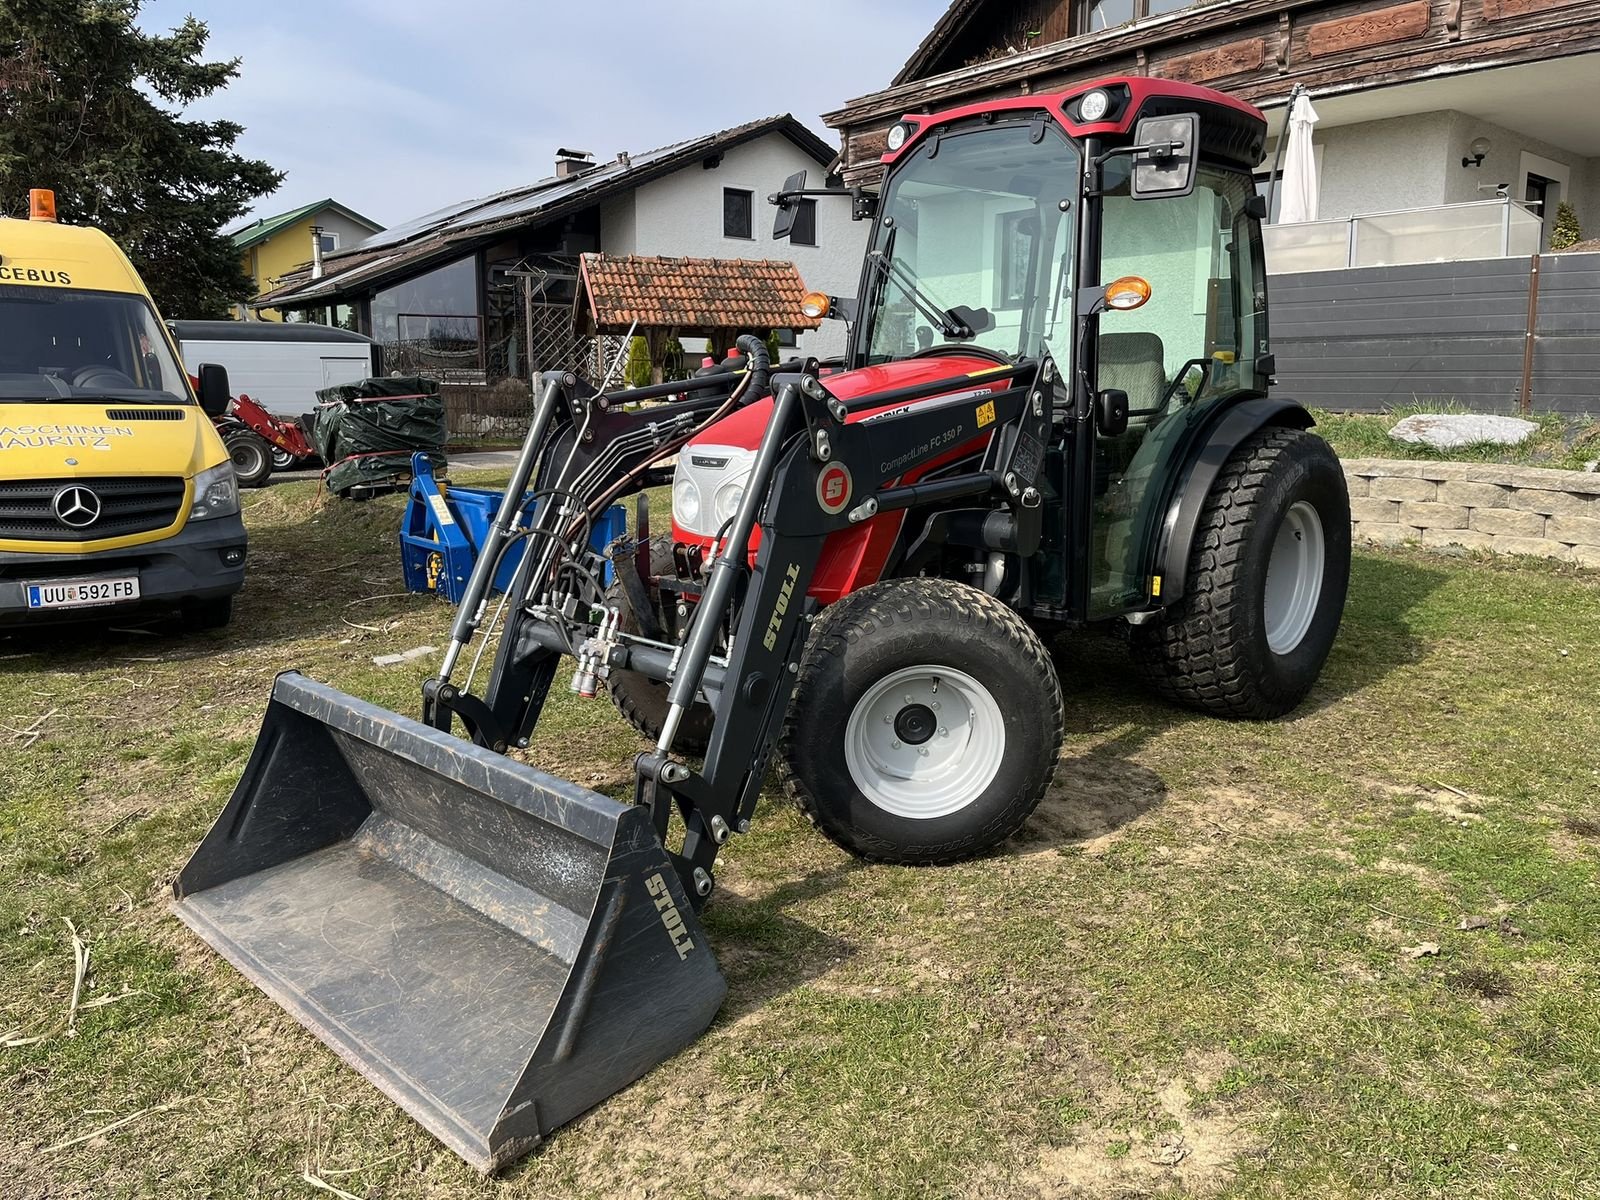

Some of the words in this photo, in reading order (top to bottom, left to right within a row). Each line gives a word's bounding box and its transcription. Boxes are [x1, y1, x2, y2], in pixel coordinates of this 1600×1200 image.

[0, 436, 109, 449] AURITZ
[881, 444, 929, 473] CompactLine
[930, 436, 941, 449] FC
[942, 428, 956, 443] 350
[957, 425, 963, 436] P
[44, 587, 65, 603] UU
[79, 584, 110, 600] 592
[113, 582, 133, 597] FB
[763, 563, 800, 652] STOLL
[645, 873, 695, 960] STOLL
